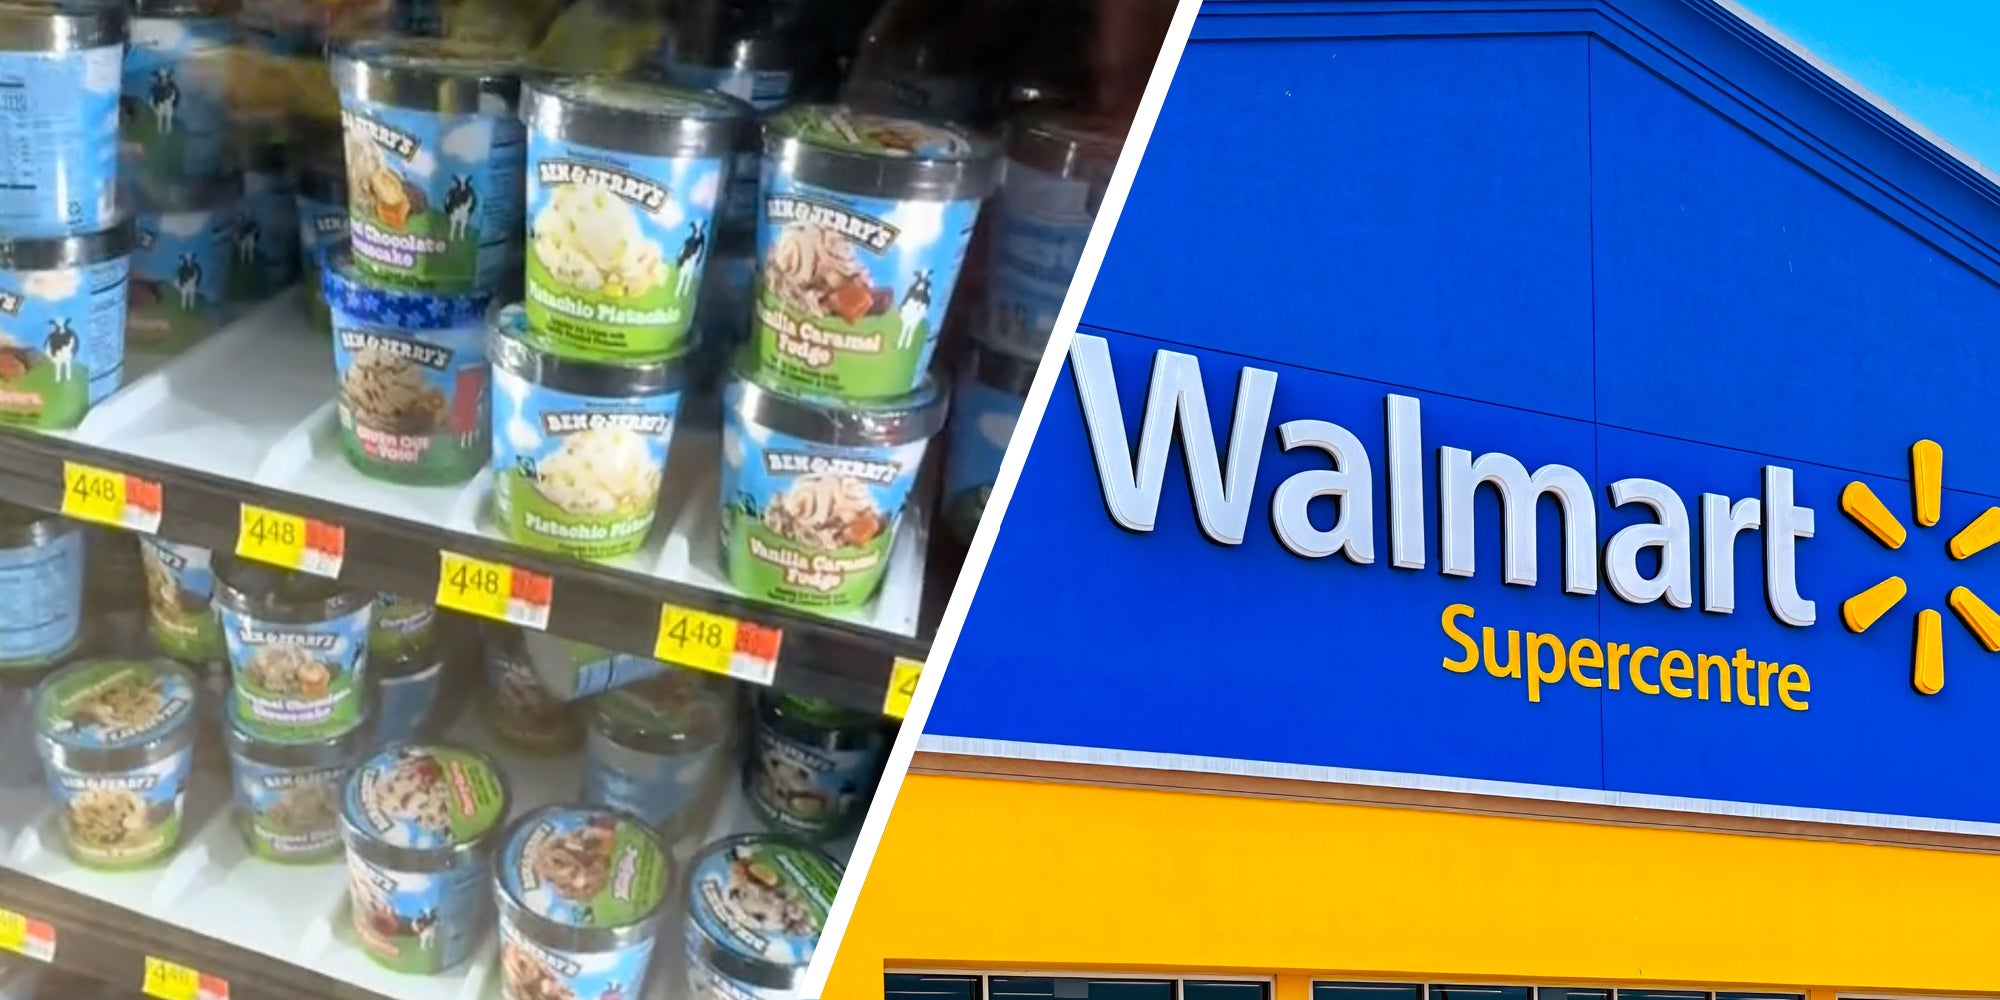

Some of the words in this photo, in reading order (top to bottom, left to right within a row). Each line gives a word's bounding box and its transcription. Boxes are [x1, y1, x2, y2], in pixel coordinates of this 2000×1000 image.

[586, 169, 667, 208] JERRY'S
[810, 204, 893, 249] JERRY'S
[778, 336, 832, 365] Fudge
[799, 321, 881, 352] Caramel
[768, 453, 809, 472] BEN
[828, 458, 899, 483] JERRY'S
[1069, 332, 1817, 627] Walmart
[525, 512, 607, 540] Pistachio
[750, 537, 809, 571] Vanilla
[786, 568, 842, 592] Fudge
[1440, 603, 1812, 712] Supercentre
